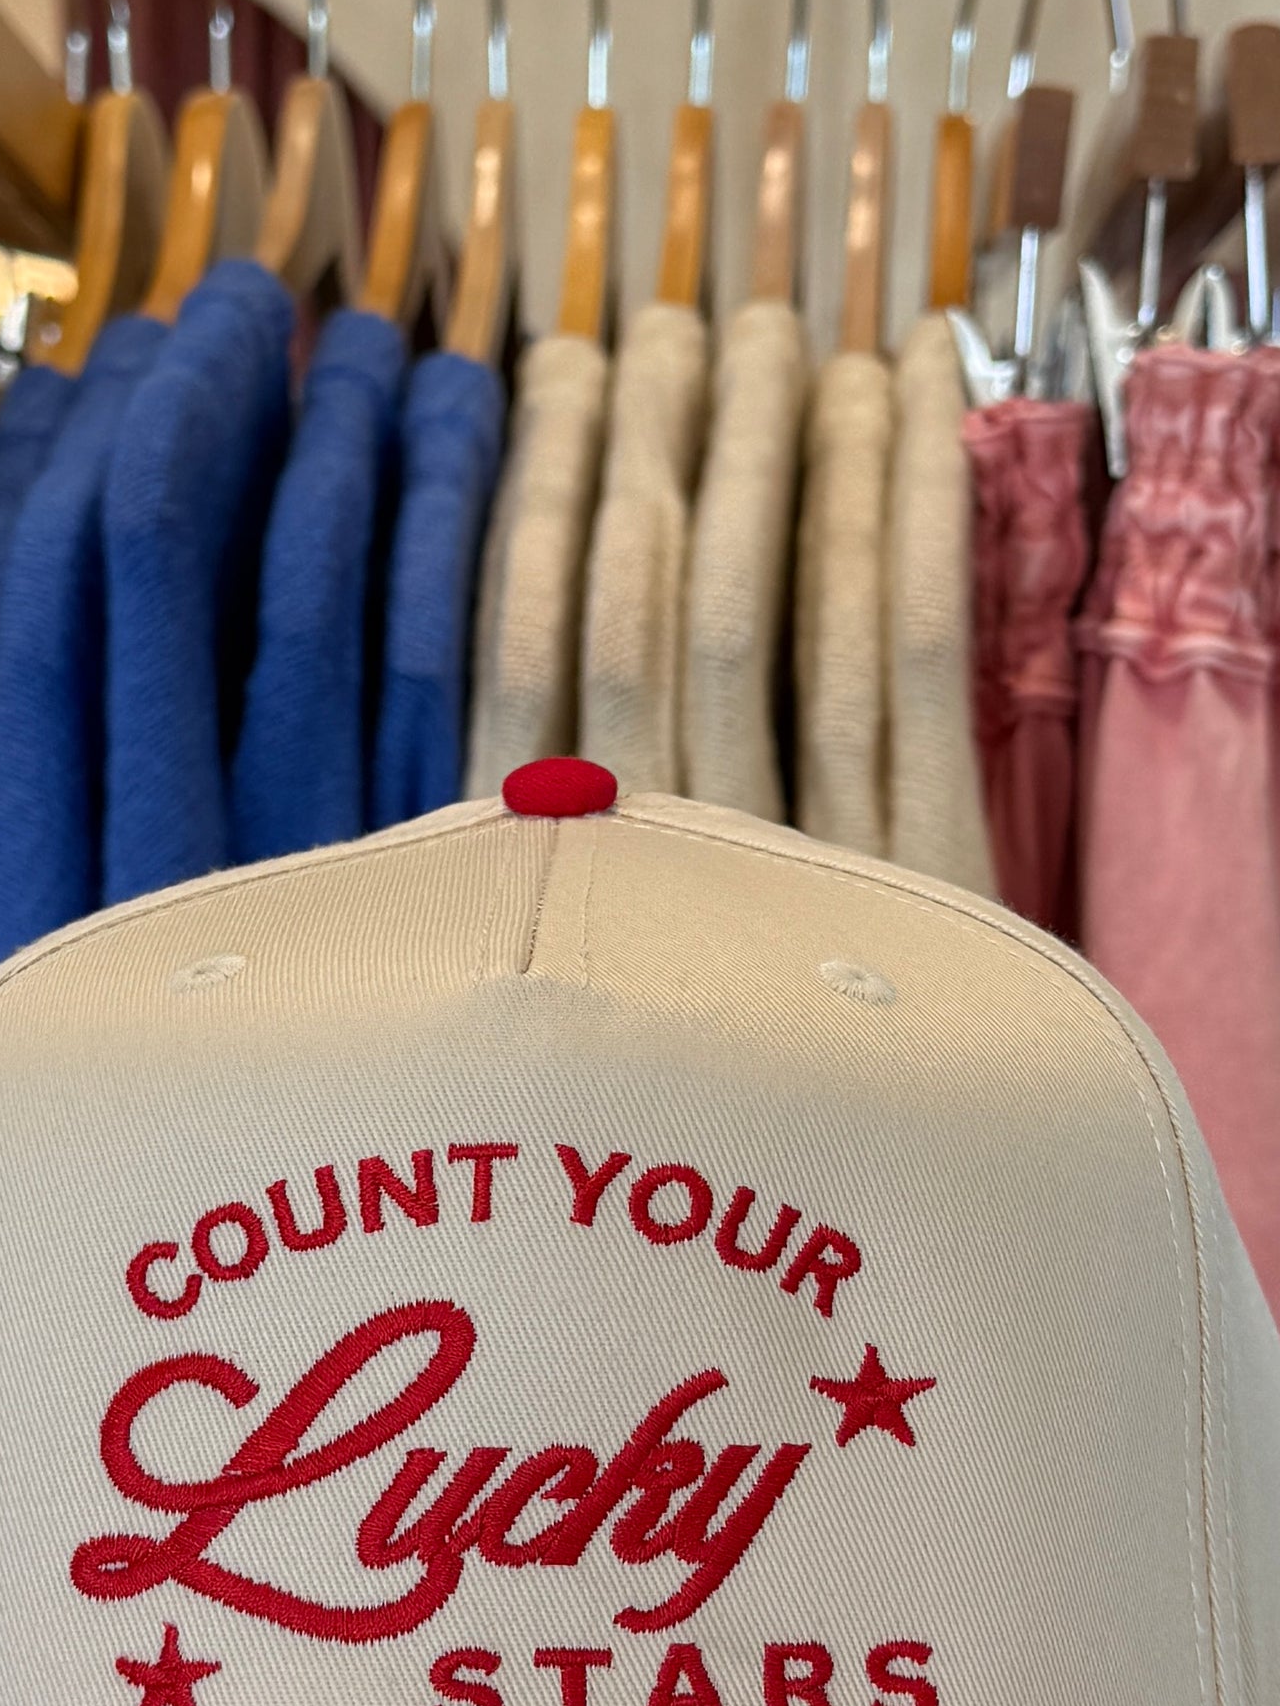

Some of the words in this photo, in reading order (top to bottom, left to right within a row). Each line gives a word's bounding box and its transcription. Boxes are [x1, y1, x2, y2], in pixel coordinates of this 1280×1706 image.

[126, 1142, 519, 1321] COUNT
[553, 1143, 863, 1319] YOUR
[70, 1298, 812, 1645] Lucky
